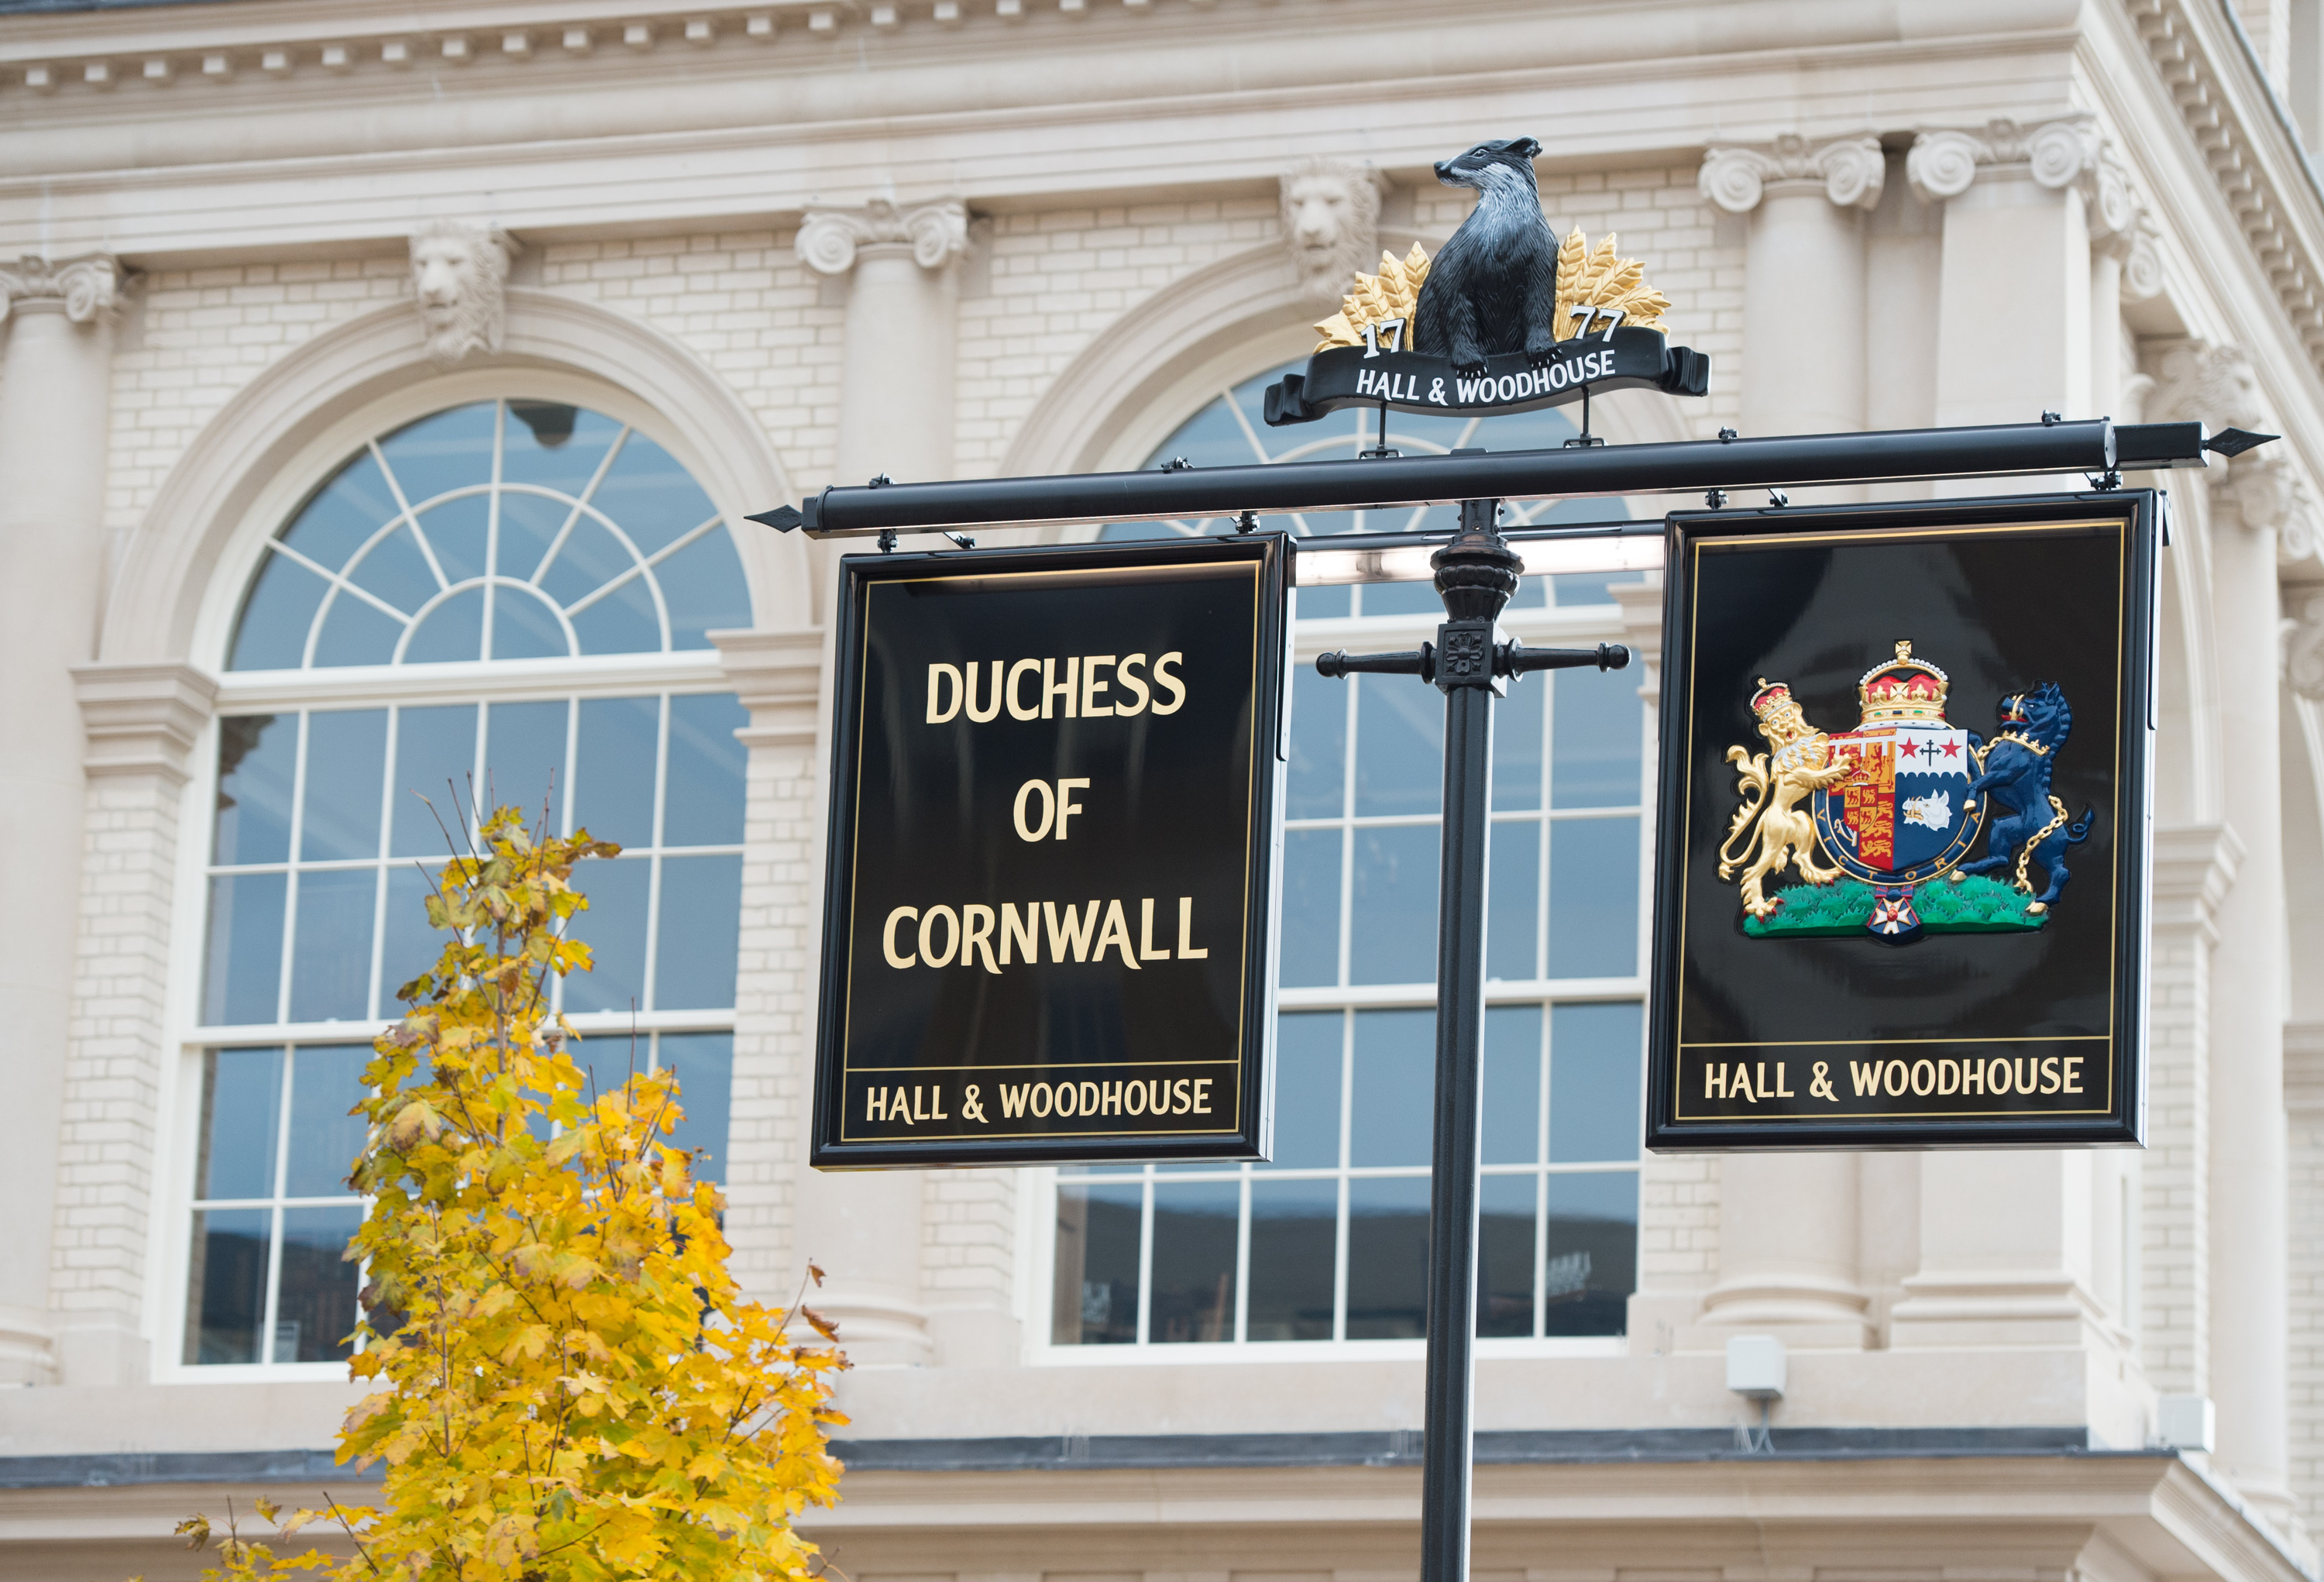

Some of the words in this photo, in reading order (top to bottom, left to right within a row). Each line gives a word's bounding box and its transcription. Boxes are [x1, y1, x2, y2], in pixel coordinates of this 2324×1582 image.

[1360, 318, 1404, 359] 17
[1569, 305, 1622, 342] 77
[1356, 370, 1420, 401] HALL
[1428, 377, 1448, 406] &
[1456, 349, 1616, 404] WOODHOUSE
[927, 651, 1186, 724] DUCHESS
[1013, 777, 1090, 842] OF
[1817, 808, 1982, 881] VICTORIA
[883, 896, 1208, 975] CORNWALL
[866, 1085, 948, 1126] HALL
[961, 1084, 988, 1123] &
[999, 1078, 1213, 1119] WOODHOUSE
[1705, 1061, 1795, 1103] HALL
[1810, 1061, 1839, 1102] &
[1850, 1057, 2084, 1097] WOODHOUSE
